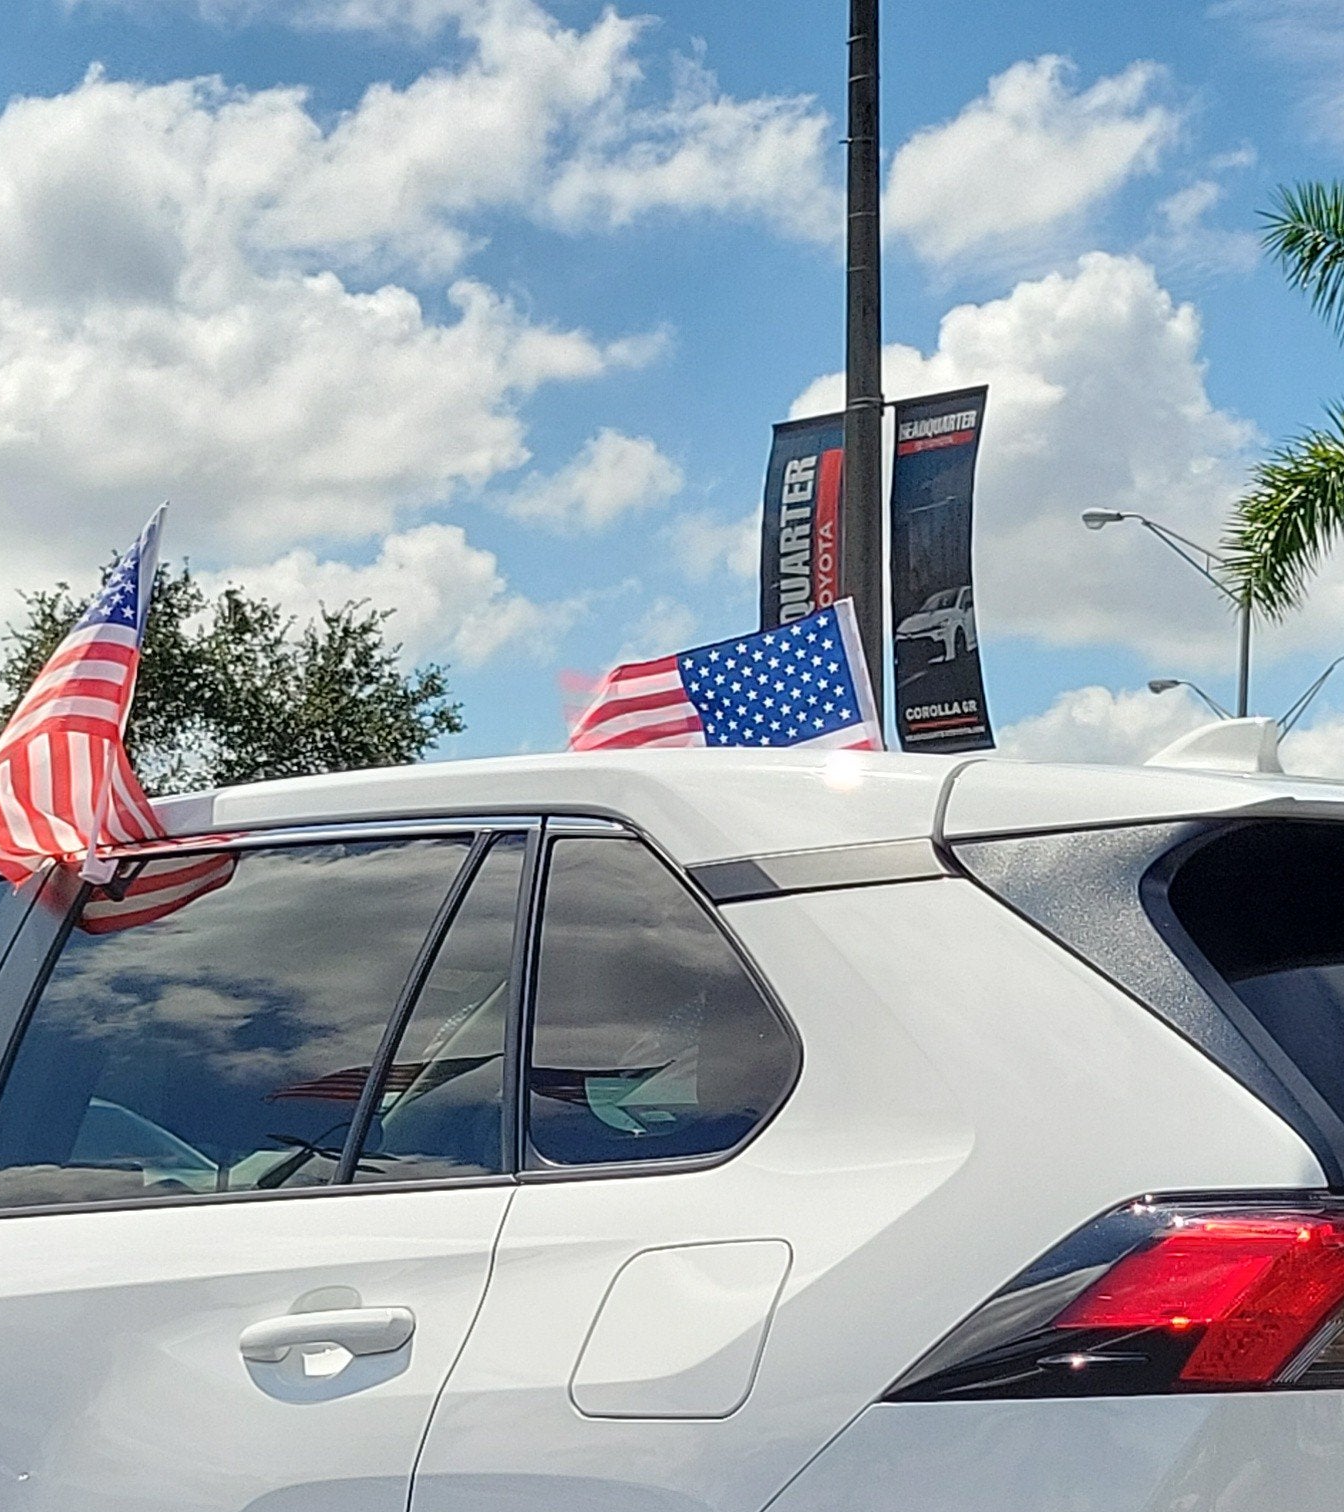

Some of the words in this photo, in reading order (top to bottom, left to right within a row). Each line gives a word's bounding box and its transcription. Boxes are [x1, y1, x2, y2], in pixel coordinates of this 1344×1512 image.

[780, 455, 817, 625] QUARTER
[818, 521, 833, 608] OYOTA
[905, 701, 961, 720] COROLLA
